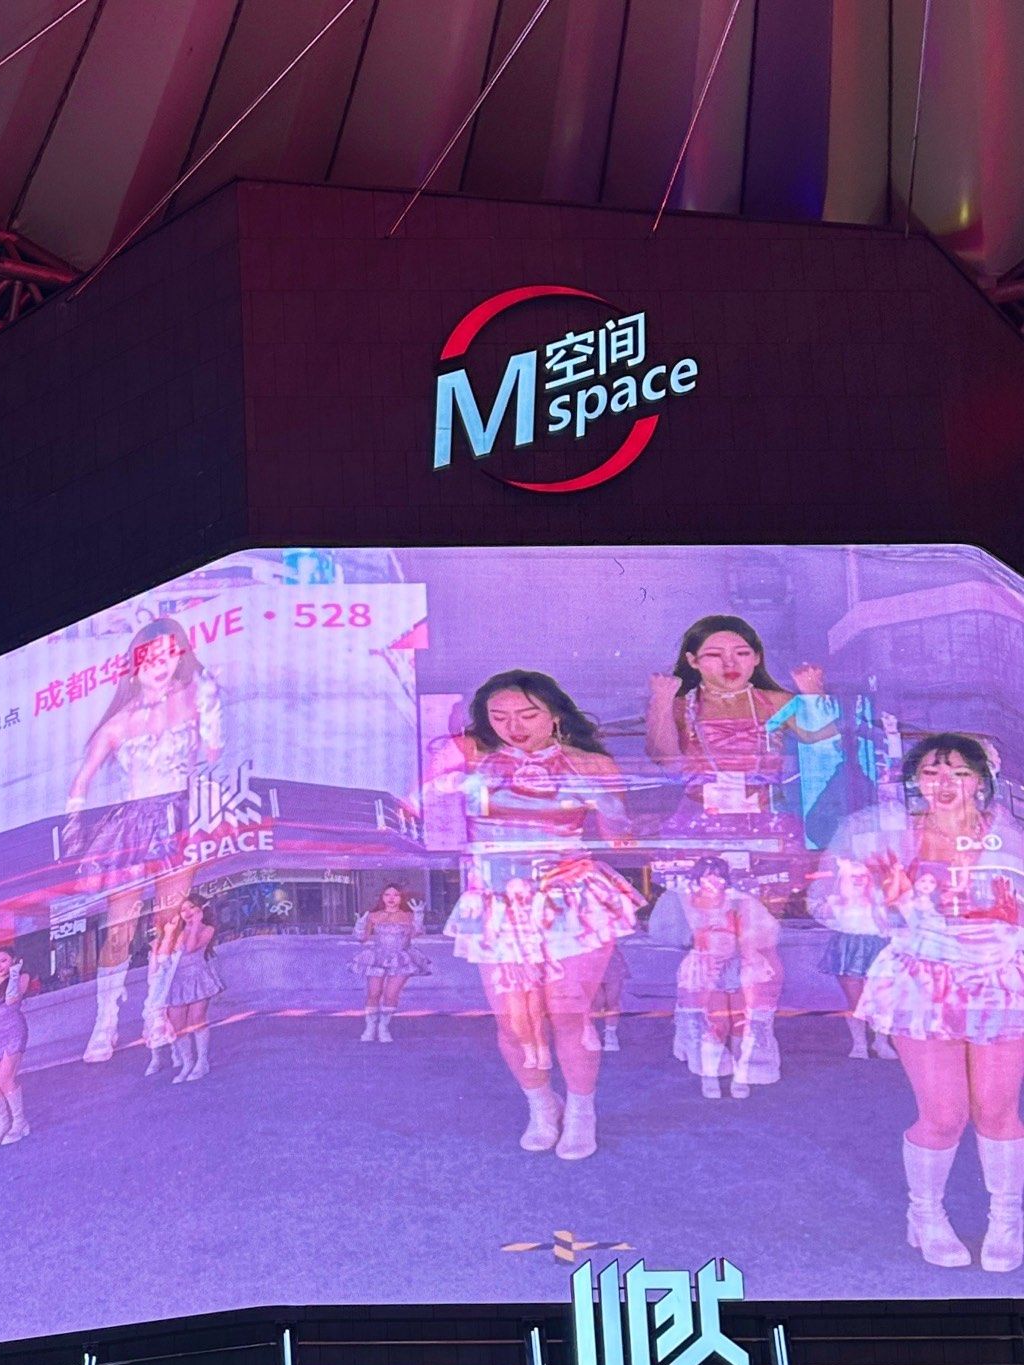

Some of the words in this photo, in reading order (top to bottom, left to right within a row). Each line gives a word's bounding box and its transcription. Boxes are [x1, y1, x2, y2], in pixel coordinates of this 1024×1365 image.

[545, 312, 645, 389] 空间
[548, 358, 698, 438] space
[294, 603, 372, 628] 528
[183, 831, 274, 866] SPACE
